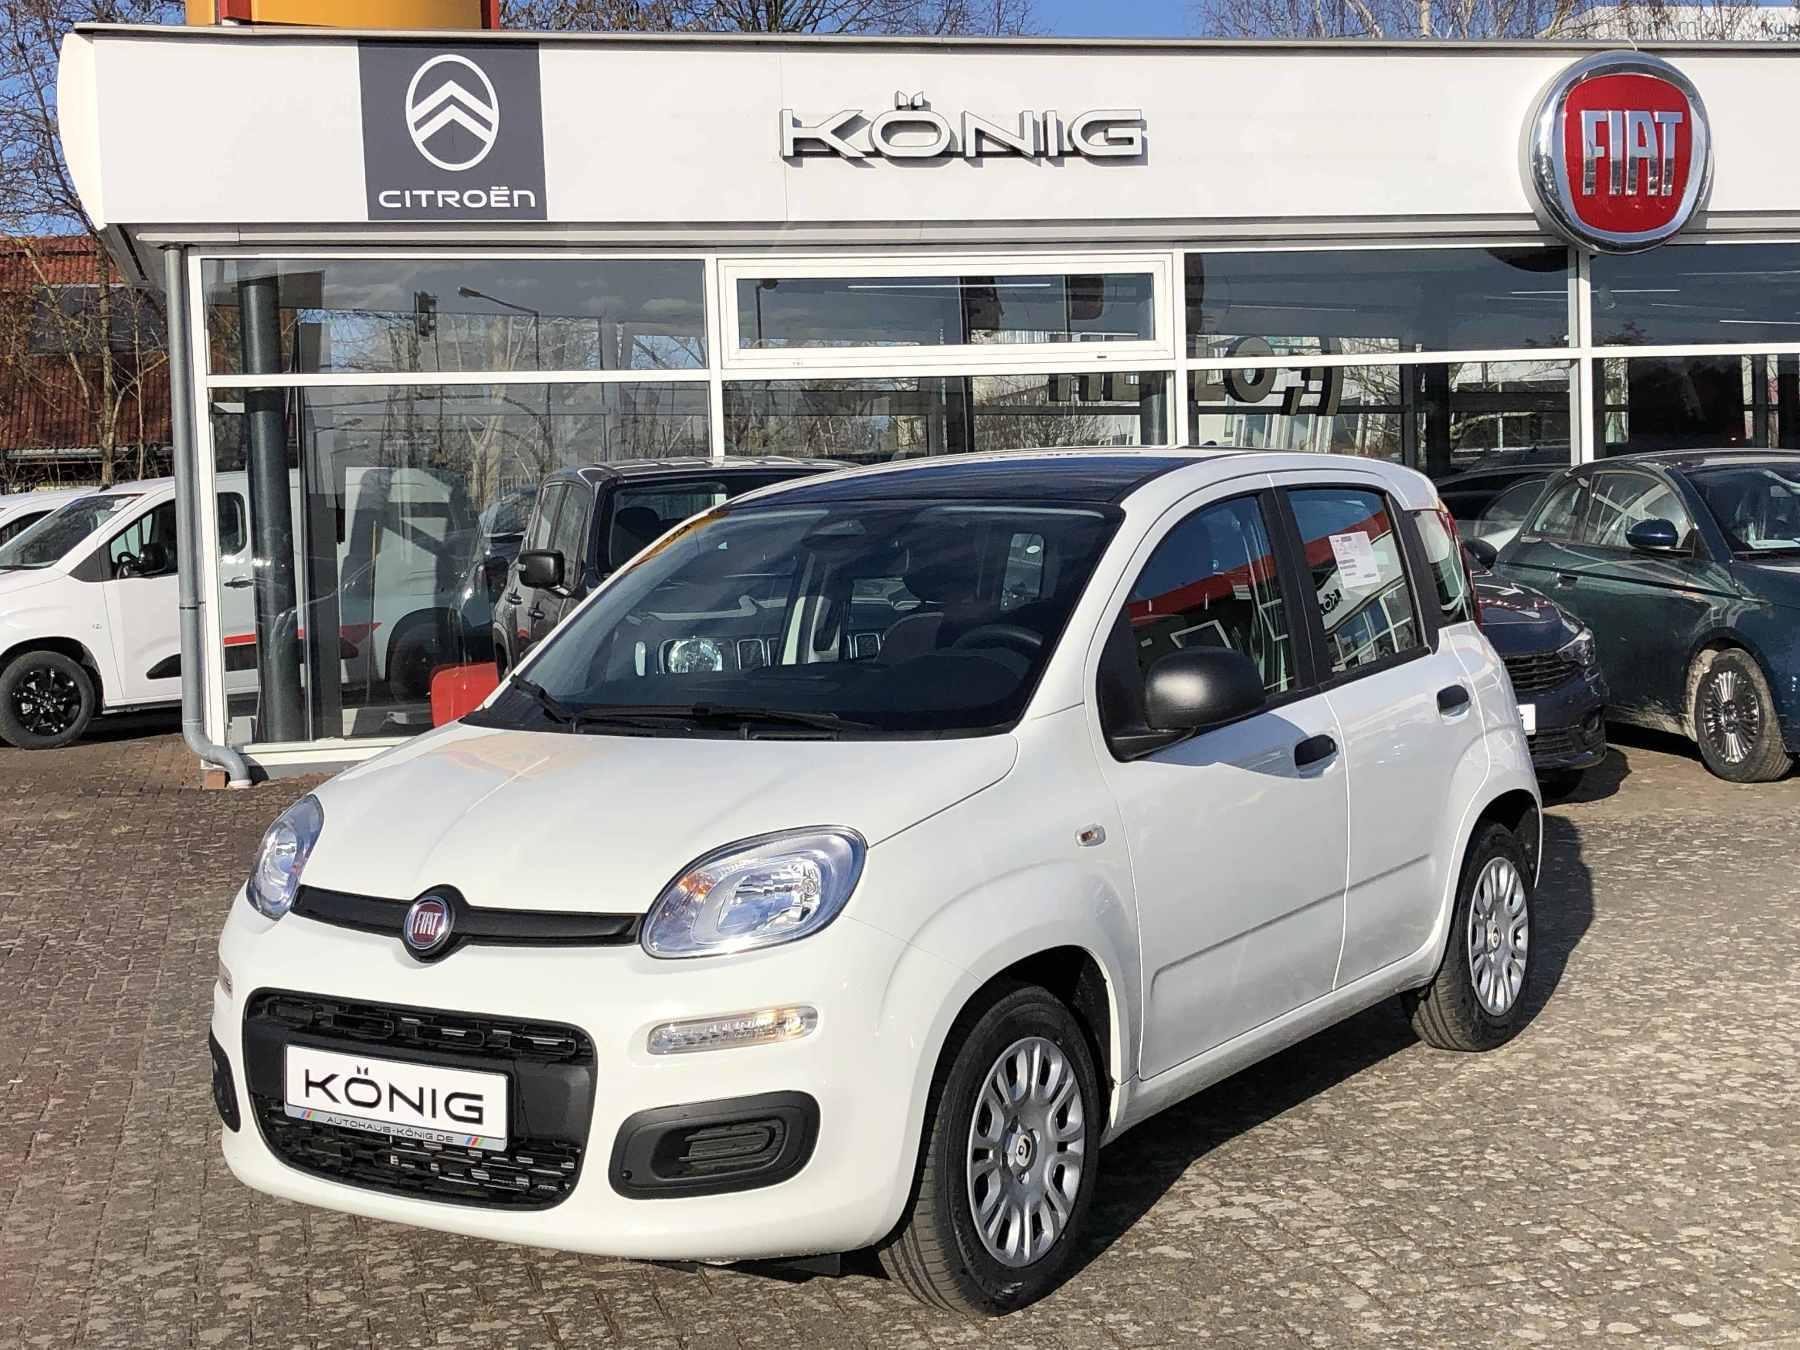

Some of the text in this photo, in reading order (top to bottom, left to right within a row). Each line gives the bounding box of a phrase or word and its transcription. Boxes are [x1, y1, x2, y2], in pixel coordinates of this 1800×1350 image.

[780, 91, 1146, 159] KÖNIG
[1580, 110, 1684, 197] FIAT
[414, 911, 442, 936] FIAT
[305, 1065, 484, 1126] KÖNIG
